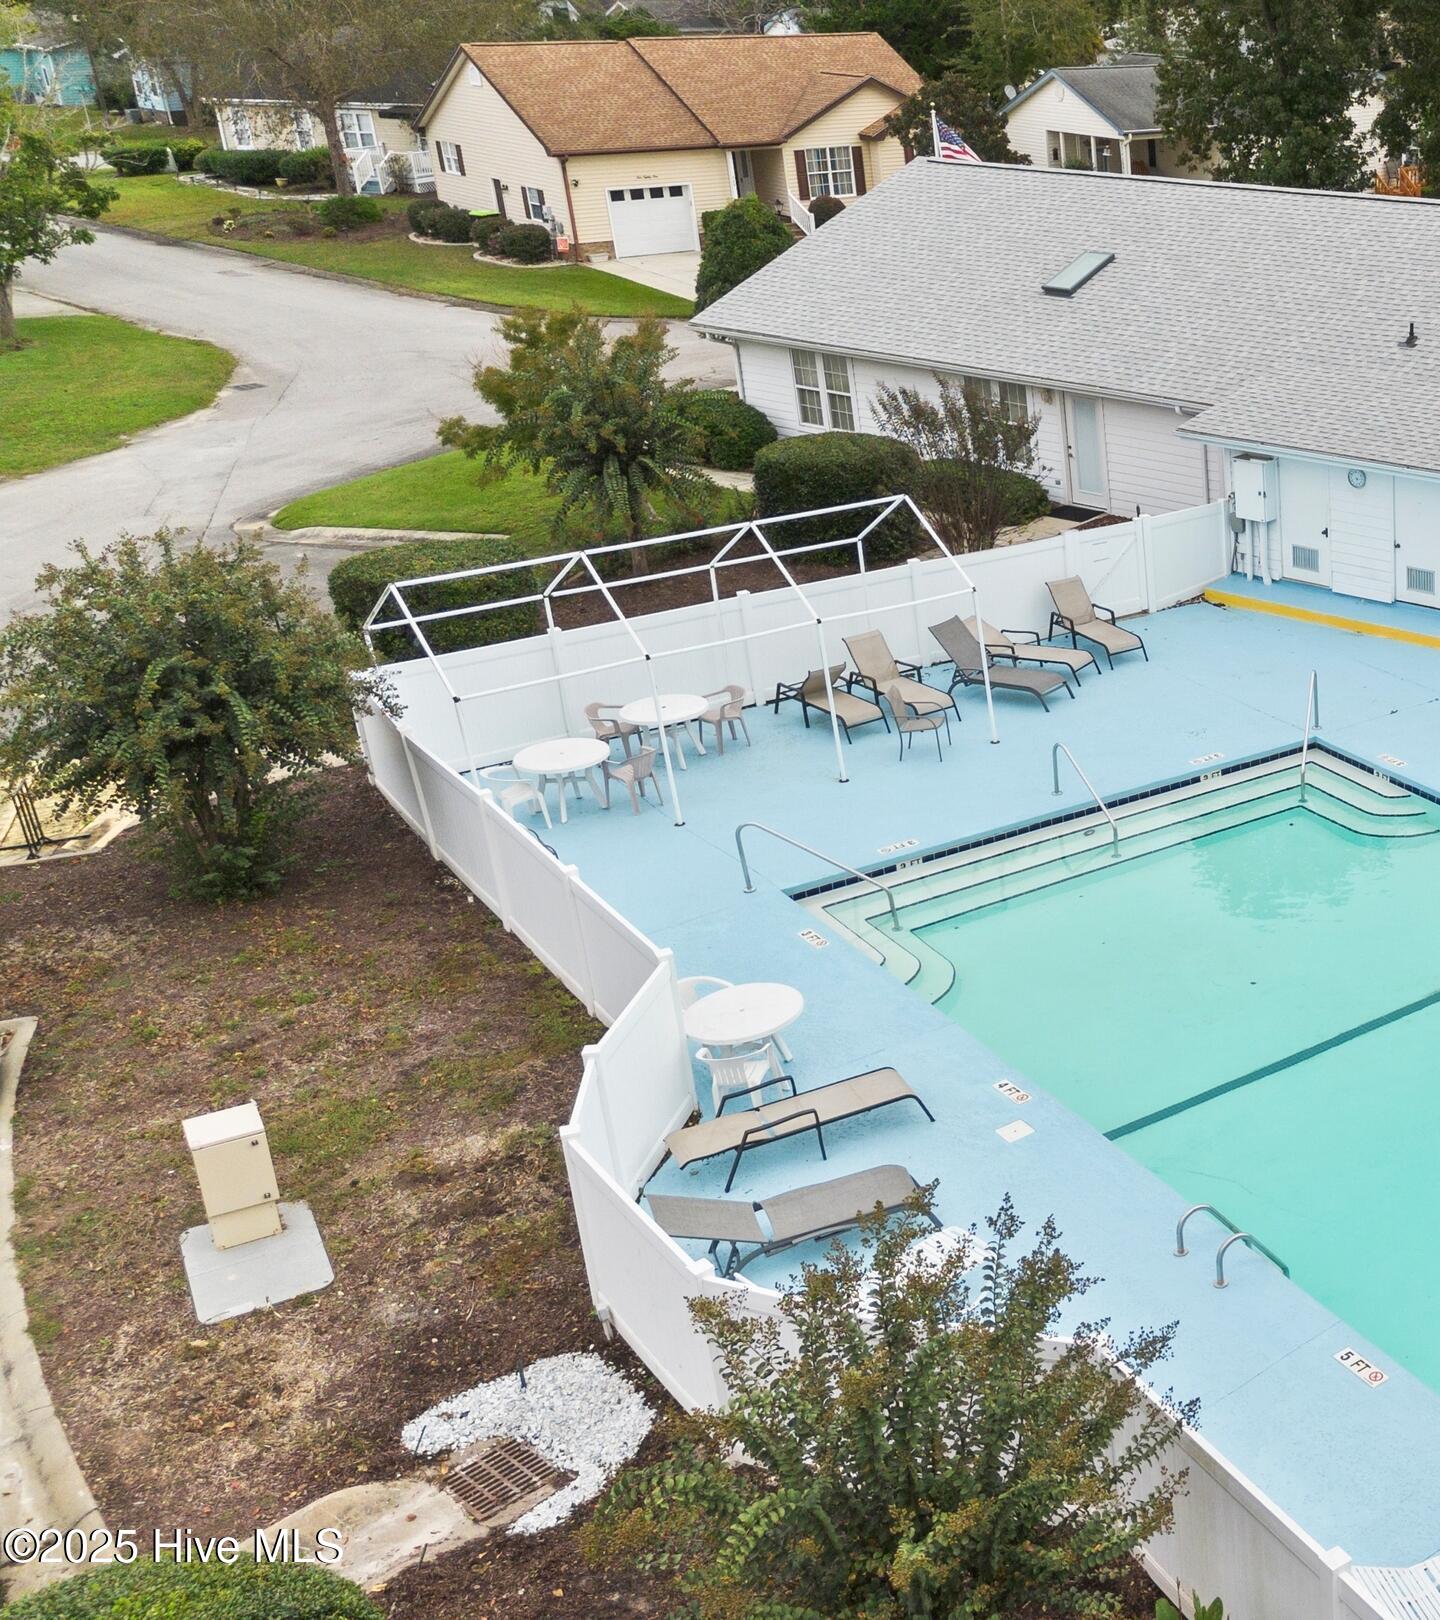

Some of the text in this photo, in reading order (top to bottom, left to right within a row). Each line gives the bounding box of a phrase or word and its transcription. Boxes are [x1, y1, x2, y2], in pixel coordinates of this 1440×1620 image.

[910, 858, 921, 866] FT
[1003, 1086, 1021, 1096] FT
[1340, 1351, 1371, 1372] 5 FT
